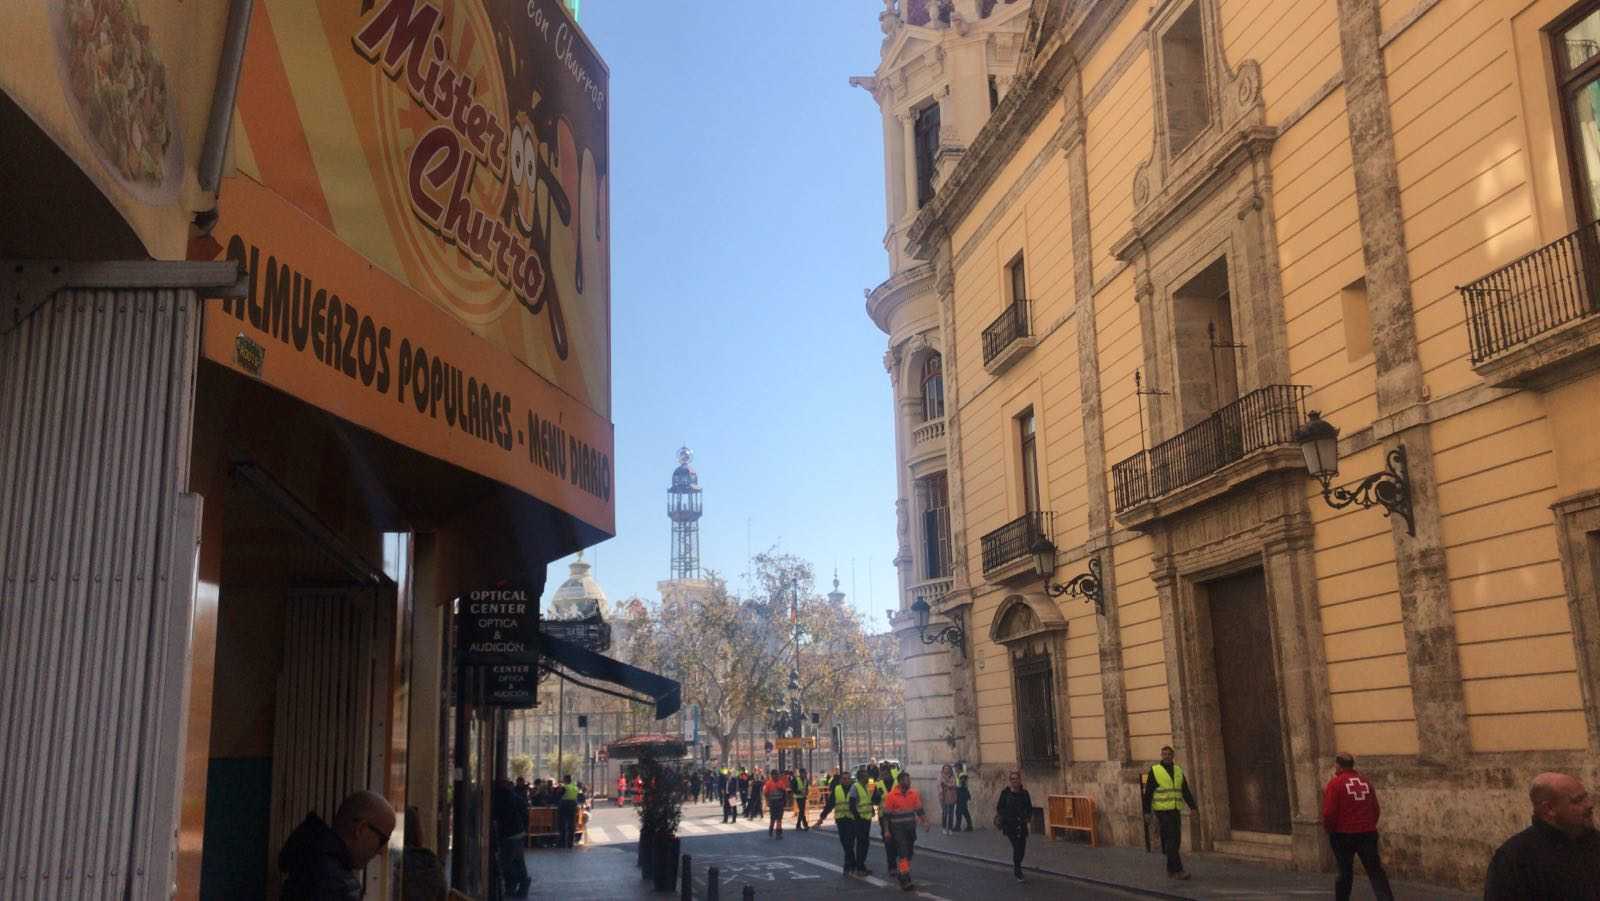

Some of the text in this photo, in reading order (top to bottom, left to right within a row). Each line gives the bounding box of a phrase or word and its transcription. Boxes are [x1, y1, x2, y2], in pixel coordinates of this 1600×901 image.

[355, 0, 510, 174] Mister
[408, 125, 544, 302] Churro
[398, 338, 513, 452] POPULARES
[528, 409, 567, 481] MENÚ
[569, 434, 610, 503] DIARIO
[470, 590, 528, 601] OPTICAL
[470, 603, 526, 614] CENTER
[493, 665, 529, 673] CENTER
